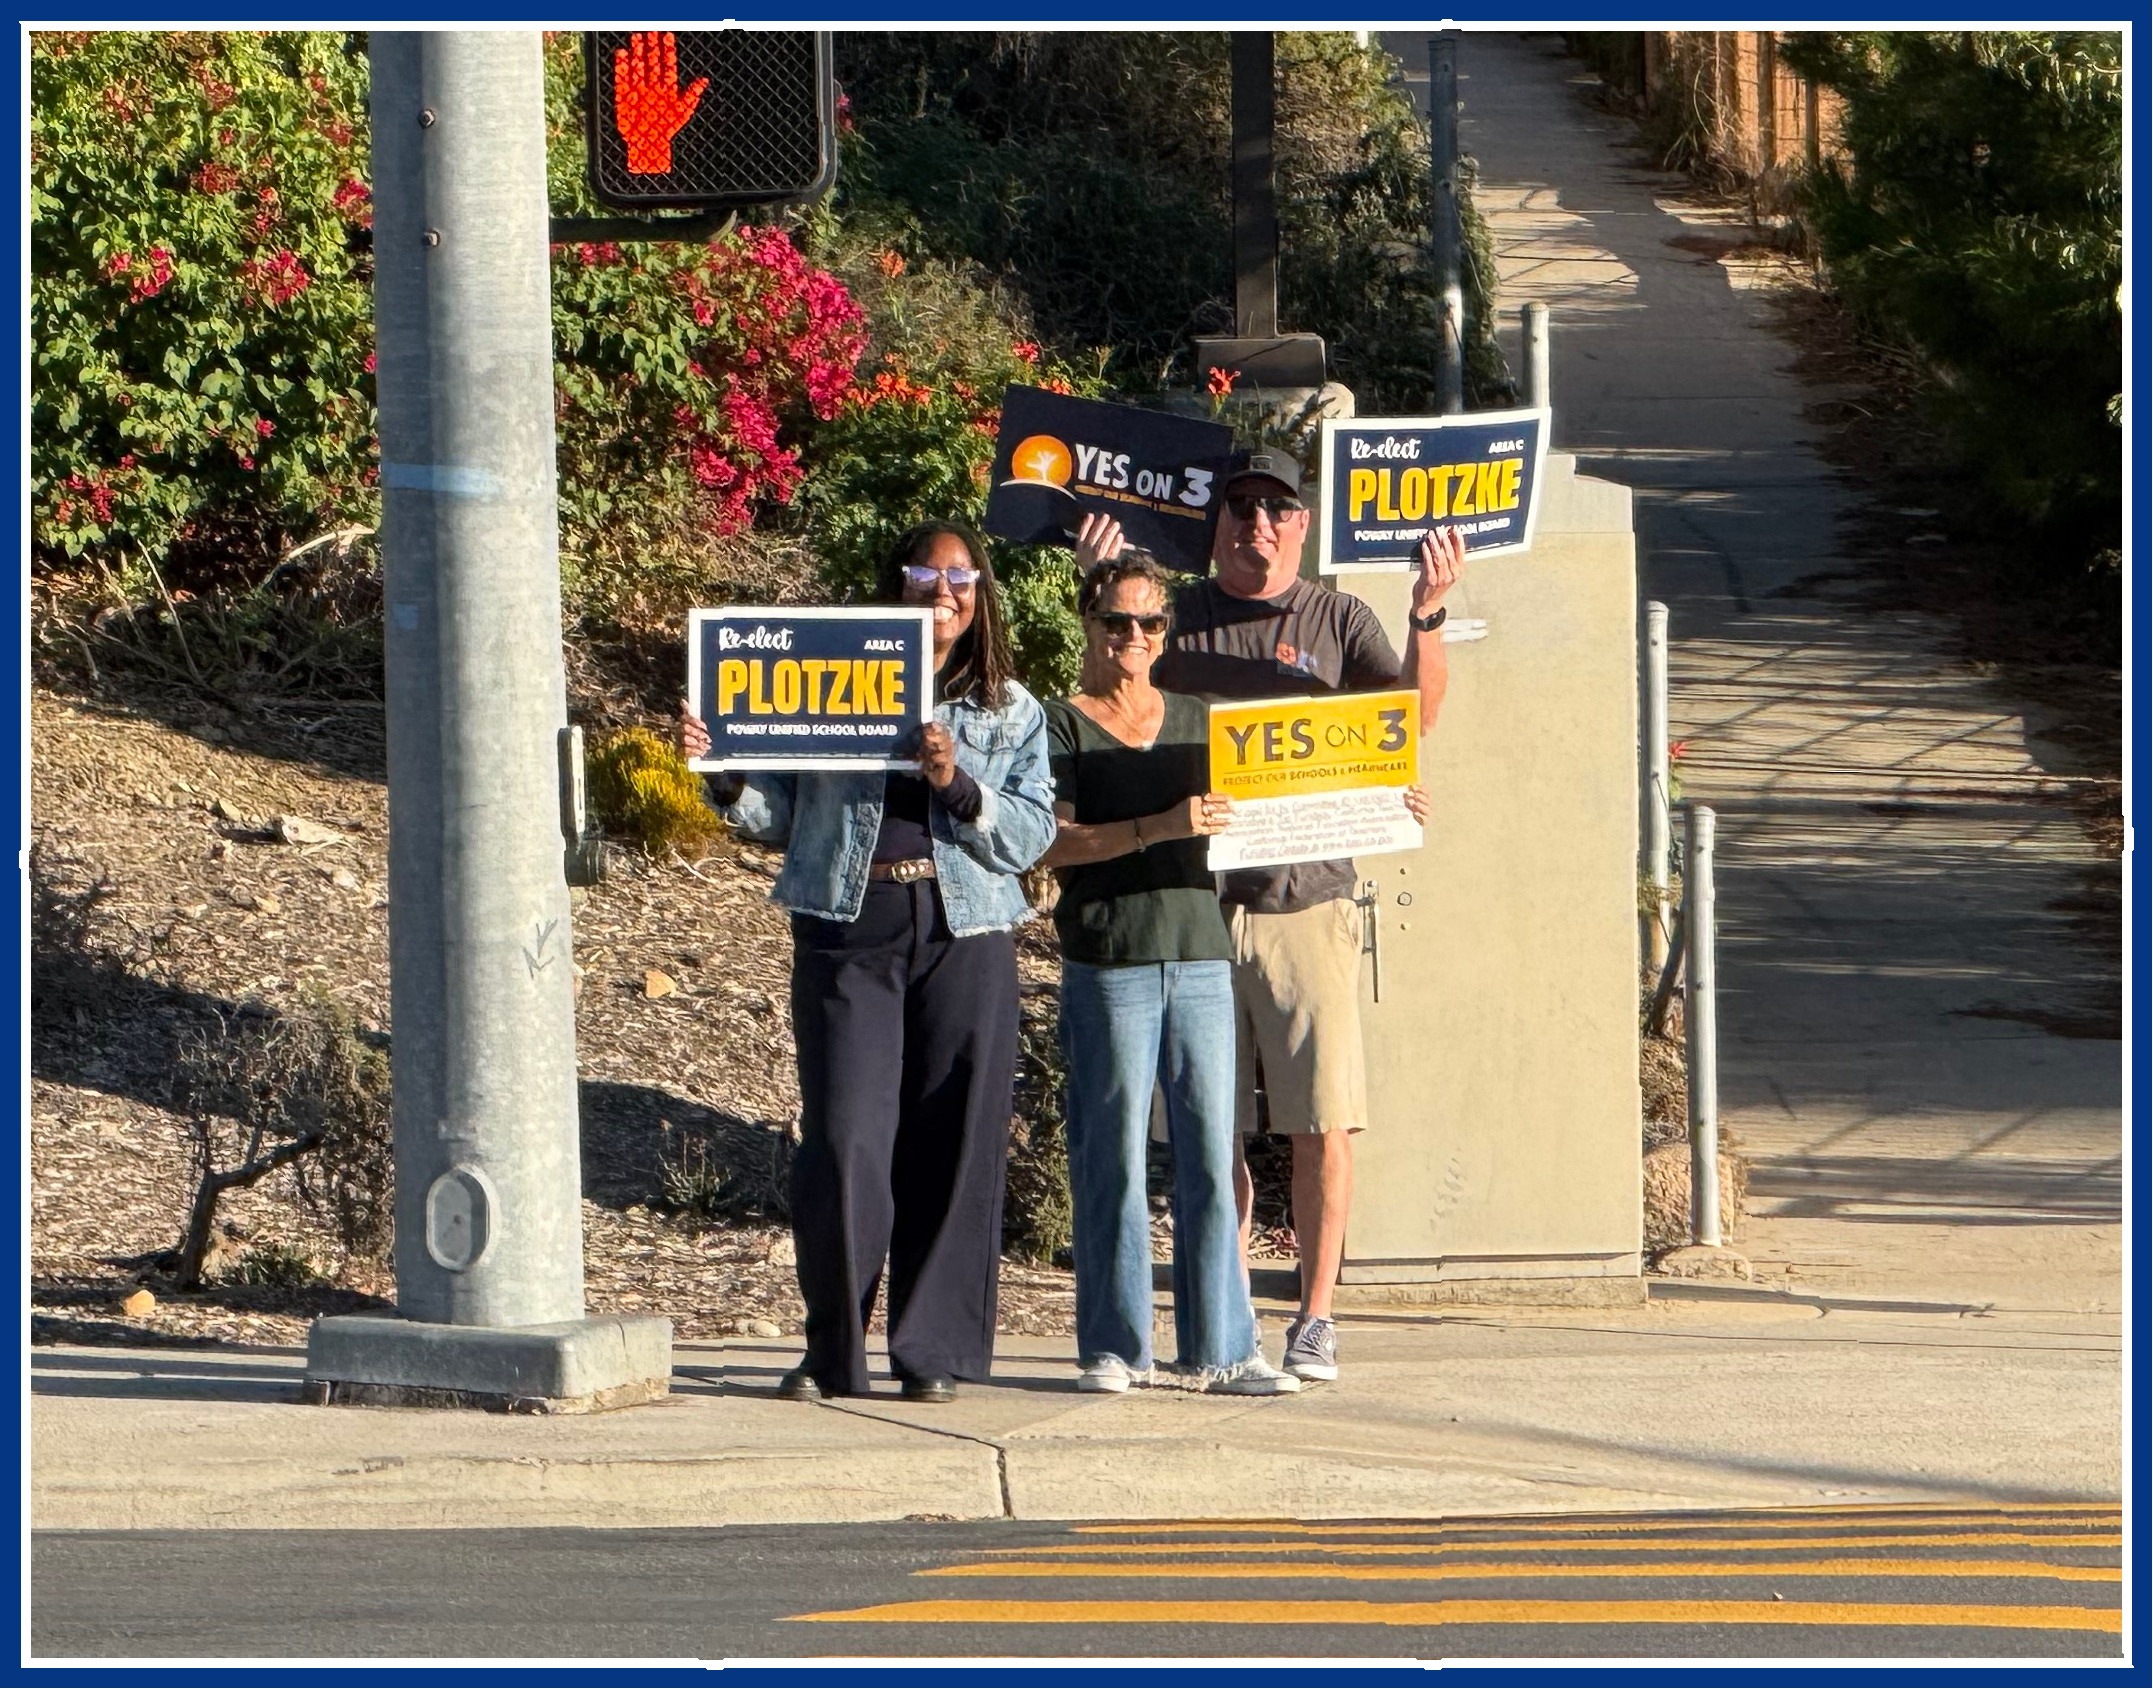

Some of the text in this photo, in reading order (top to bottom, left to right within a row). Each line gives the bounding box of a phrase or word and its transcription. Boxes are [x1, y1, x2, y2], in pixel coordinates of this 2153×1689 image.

[1075, 444, 1131, 489] YES
[1135, 469, 1173, 500] ON
[1178, 466, 1213, 507] 3
[1351, 437, 1421, 460] Re-elect
[1349, 458, 1523, 522] PLOTZKE
[719, 625, 794, 651] Re-elect
[718, 659, 906, 716] PLOTZKE
[812, 724, 857, 737] SCHOOL
[858, 724, 898, 737] BOARD
[1225, 708, 1407, 766] YES ON 3
